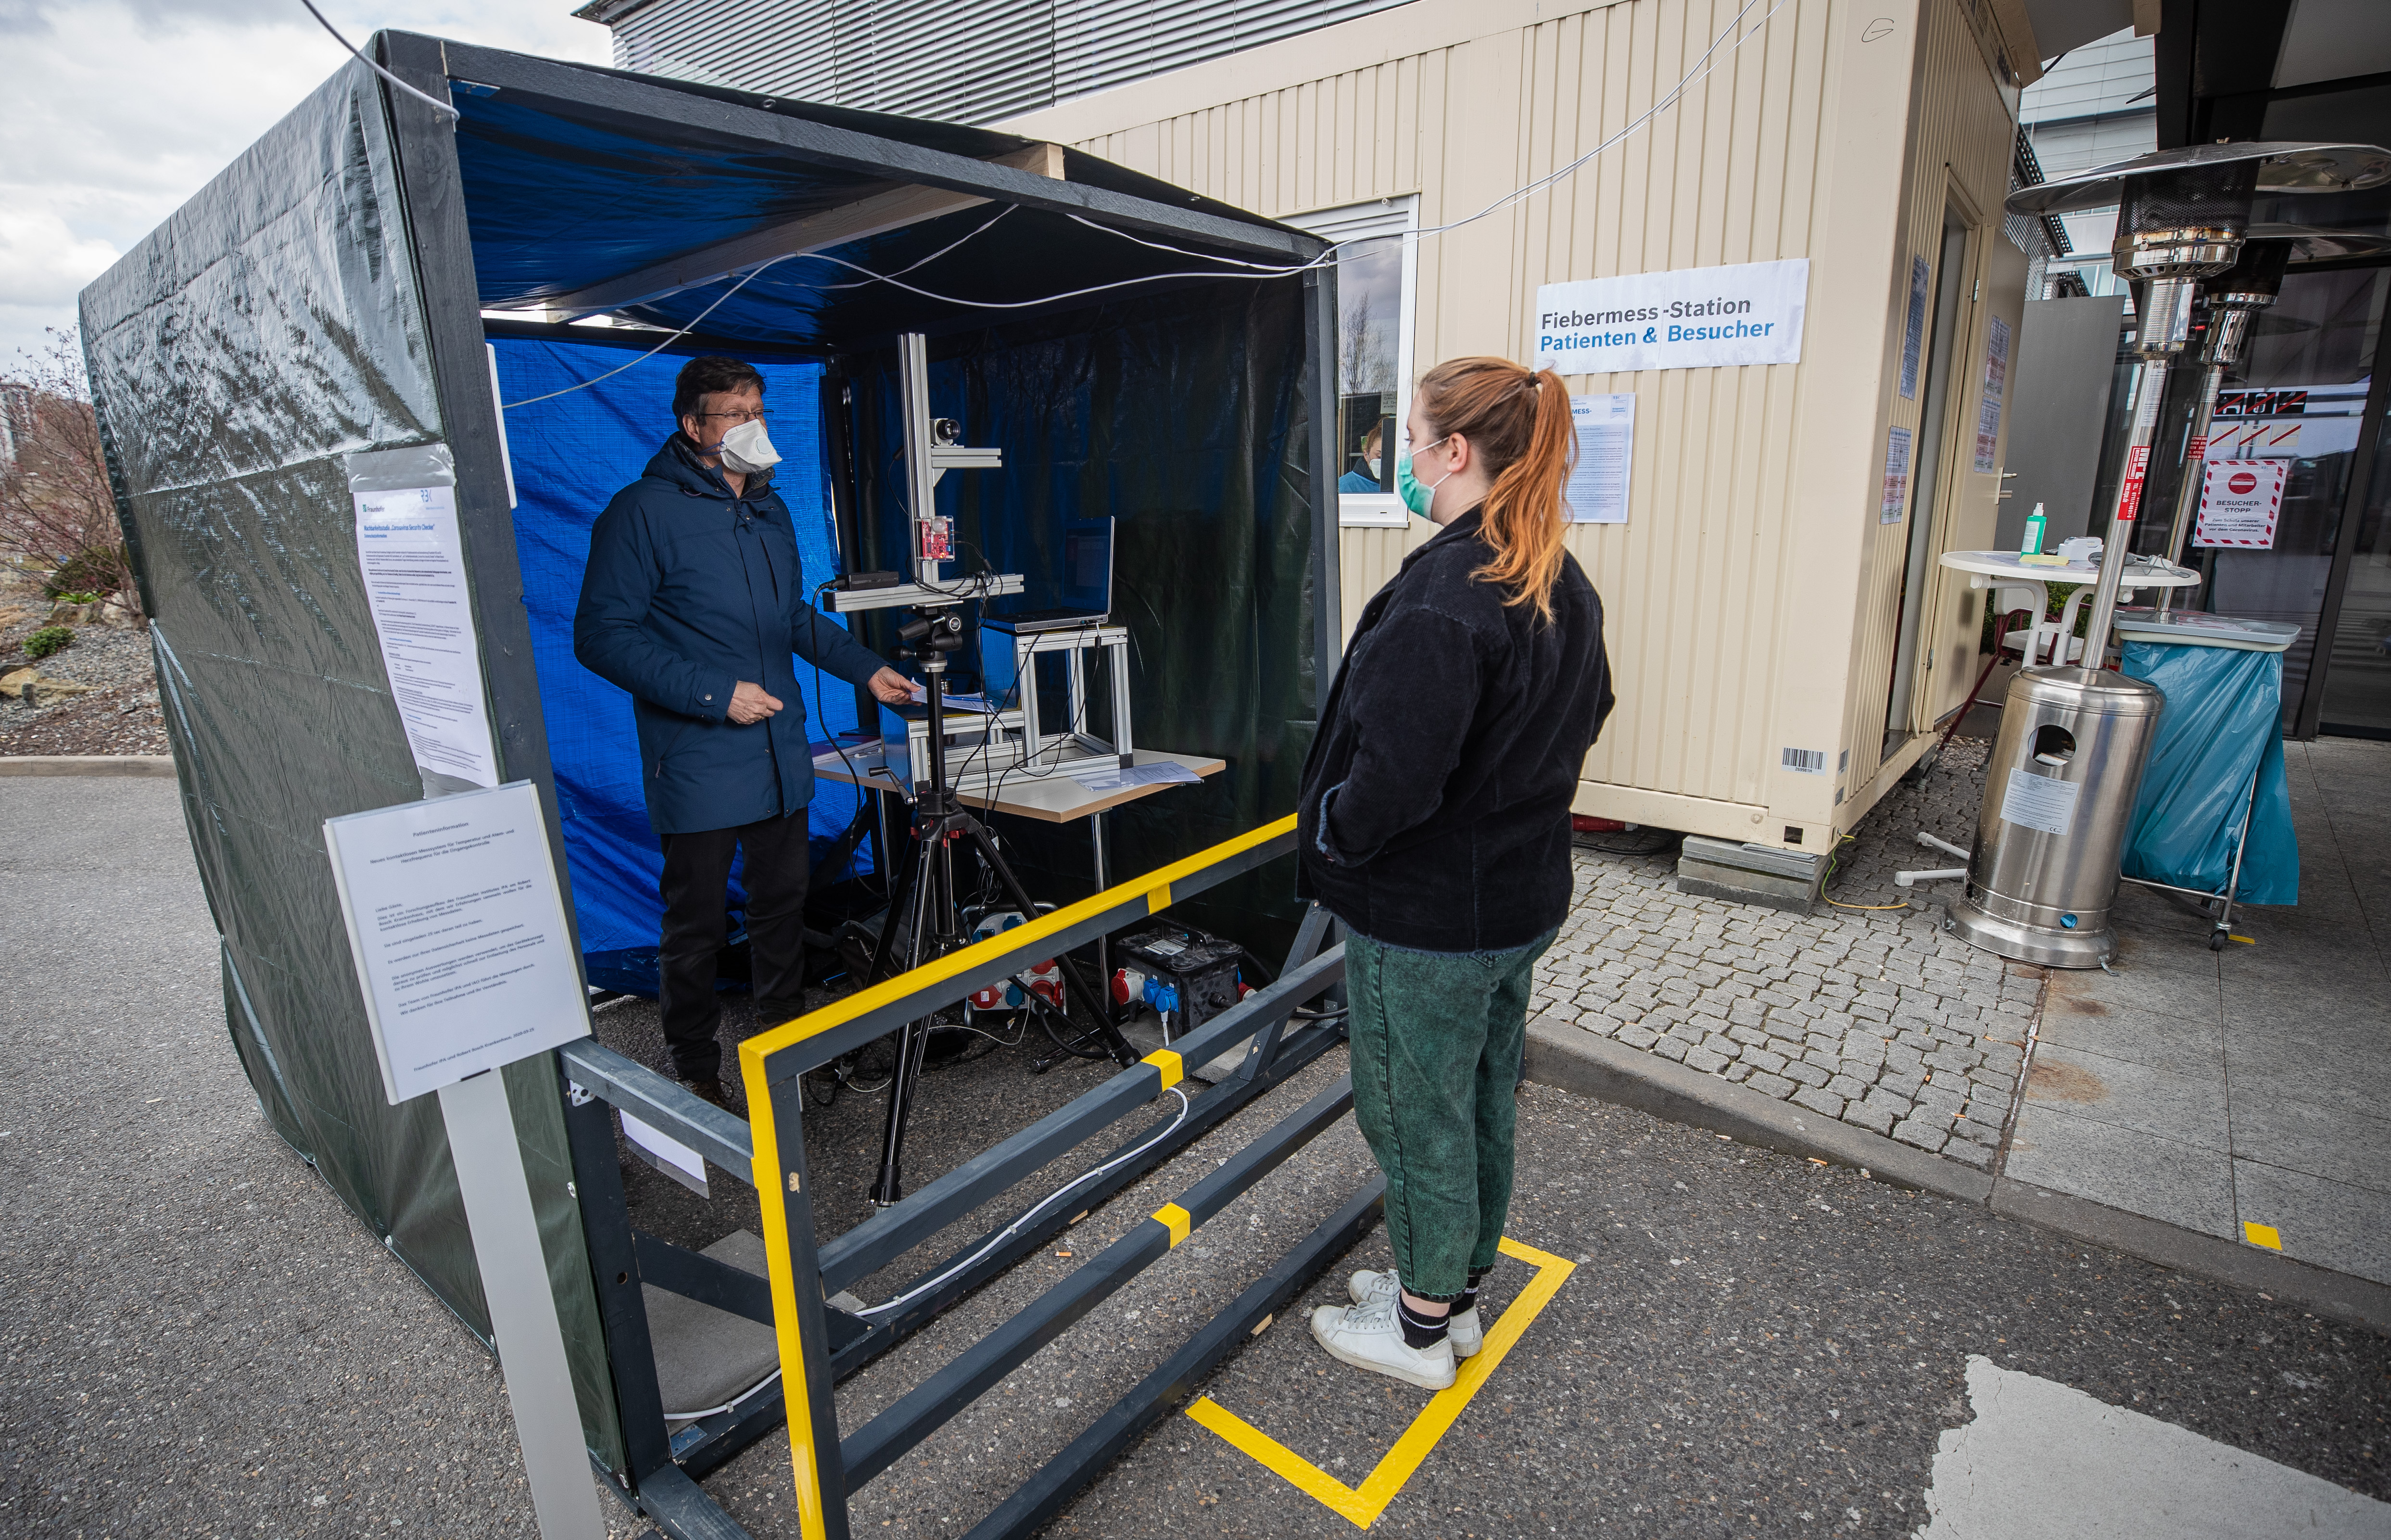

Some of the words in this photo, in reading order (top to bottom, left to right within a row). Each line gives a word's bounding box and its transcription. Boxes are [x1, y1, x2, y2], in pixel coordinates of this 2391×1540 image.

[1541, 330, 1636, 352] Patienten
[1643, 327, 1657, 343] &
[1668, 319, 1774, 342] Besucher
[413, 822, 468, 837] Patienteninformation
[418, 845, 446, 853] Messsystem
[401, 854, 432, 863] Herzfrequenz
[405, 901, 444, 913] Forschungsaufbau
[456, 892, 479, 900] Fraunhofer
[455, 897, 481, 906] Erfahrungen
[380, 922, 406, 932] kontaktlose
[402, 934, 426, 943] eingeladen
[431, 940, 464, 952] Datensicherheit
[477, 931, 499, 939] Messdaten
[401, 969, 424, 978] anonymen
[425, 959, 456, 971] Auswertungen
[514, 934, 544, 945] Gerätekonzept
[486, 950, 508, 959] Entlastung
[430, 988, 453, 997] Fraunhofer
[499, 968, 522, 976] Messungen
[443, 993, 466, 1002] Teilnahme
[414, 1061, 438, 1072] Fraunhofer
